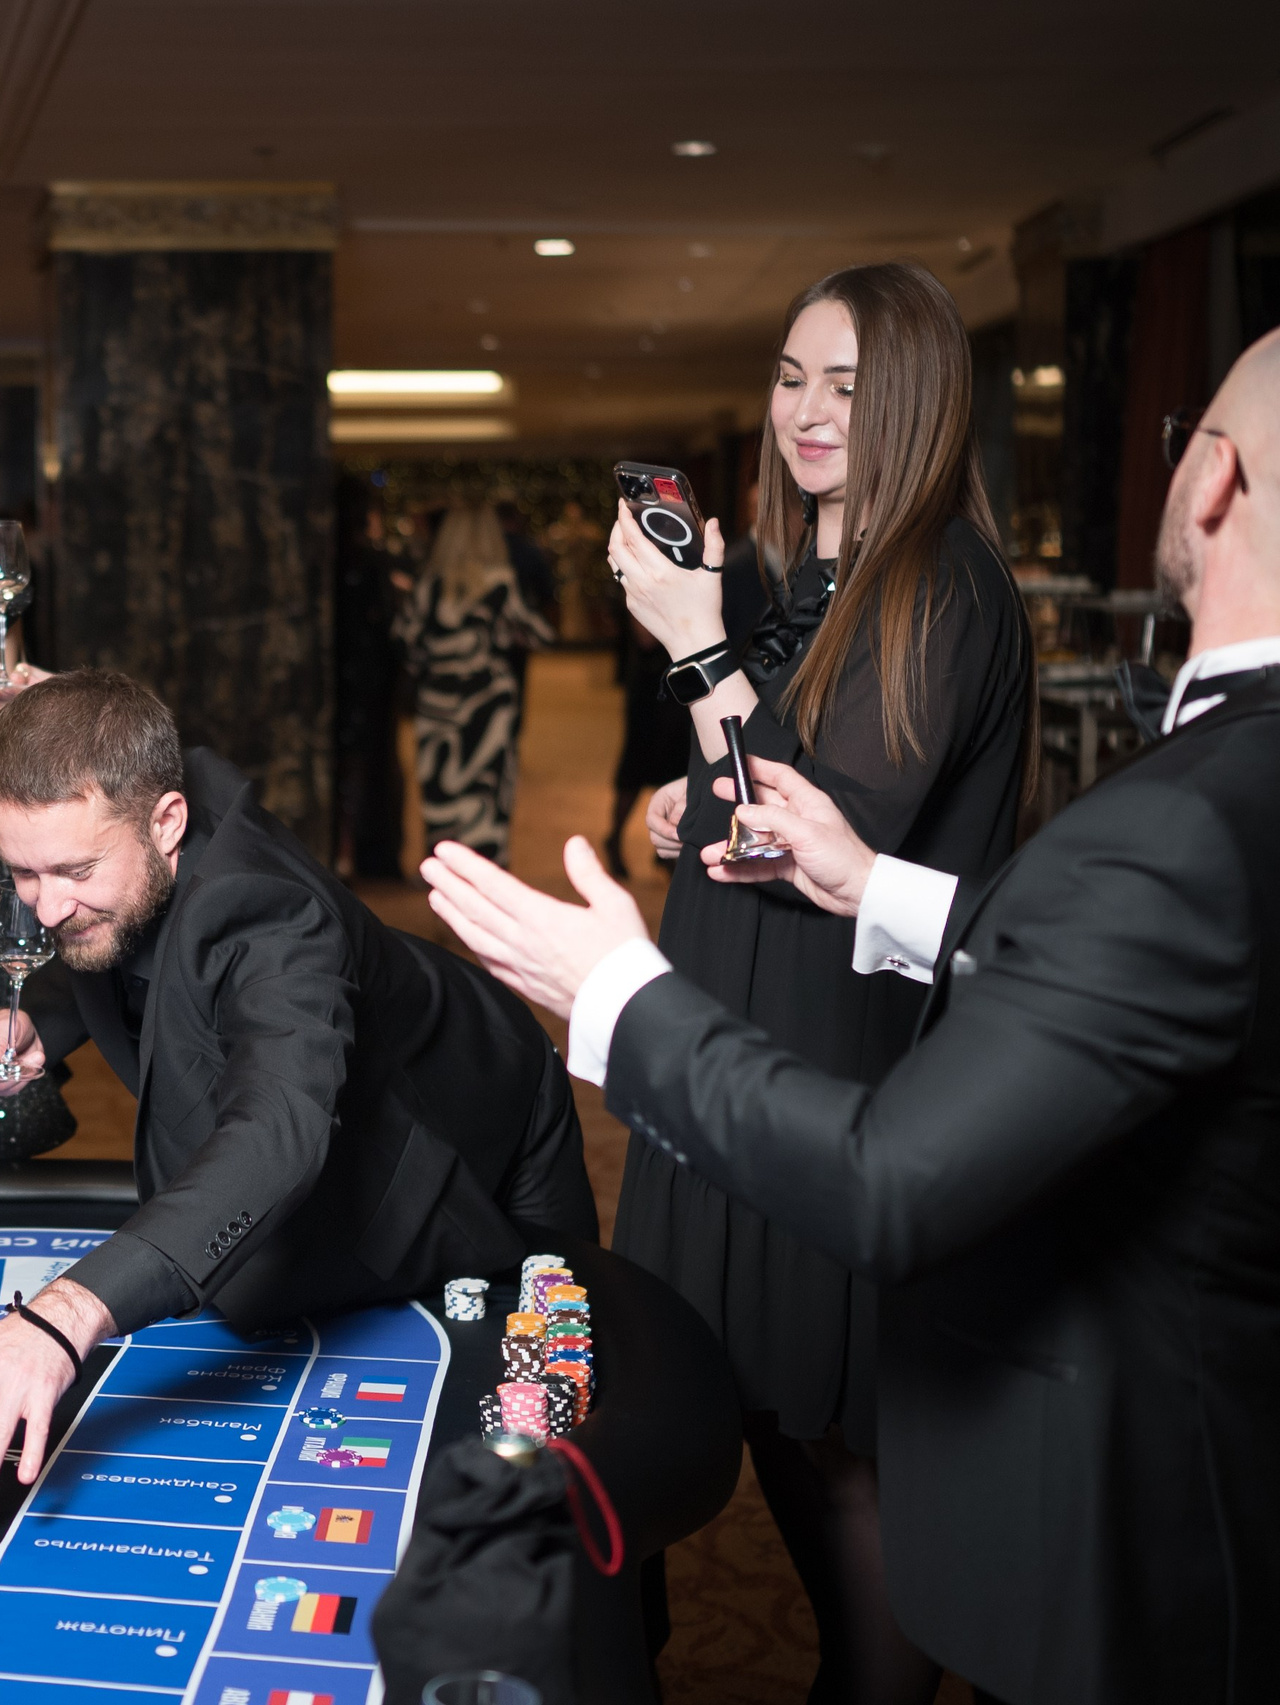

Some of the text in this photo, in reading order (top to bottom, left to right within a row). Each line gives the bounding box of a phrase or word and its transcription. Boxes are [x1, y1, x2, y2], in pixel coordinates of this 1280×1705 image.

[187, 1369, 282, 1383] Каберне
[227, 1364, 286, 1374] Фран
[320, 1373, 348, 1399] ФРАНЦИЯ
[159, 1417, 262, 1432] Мальбек
[81, 1473, 238, 1492] Санджовезе
[33, 1538, 215, 1563] Темпранильо
[56, 1620, 186, 1643] Пинотаж
